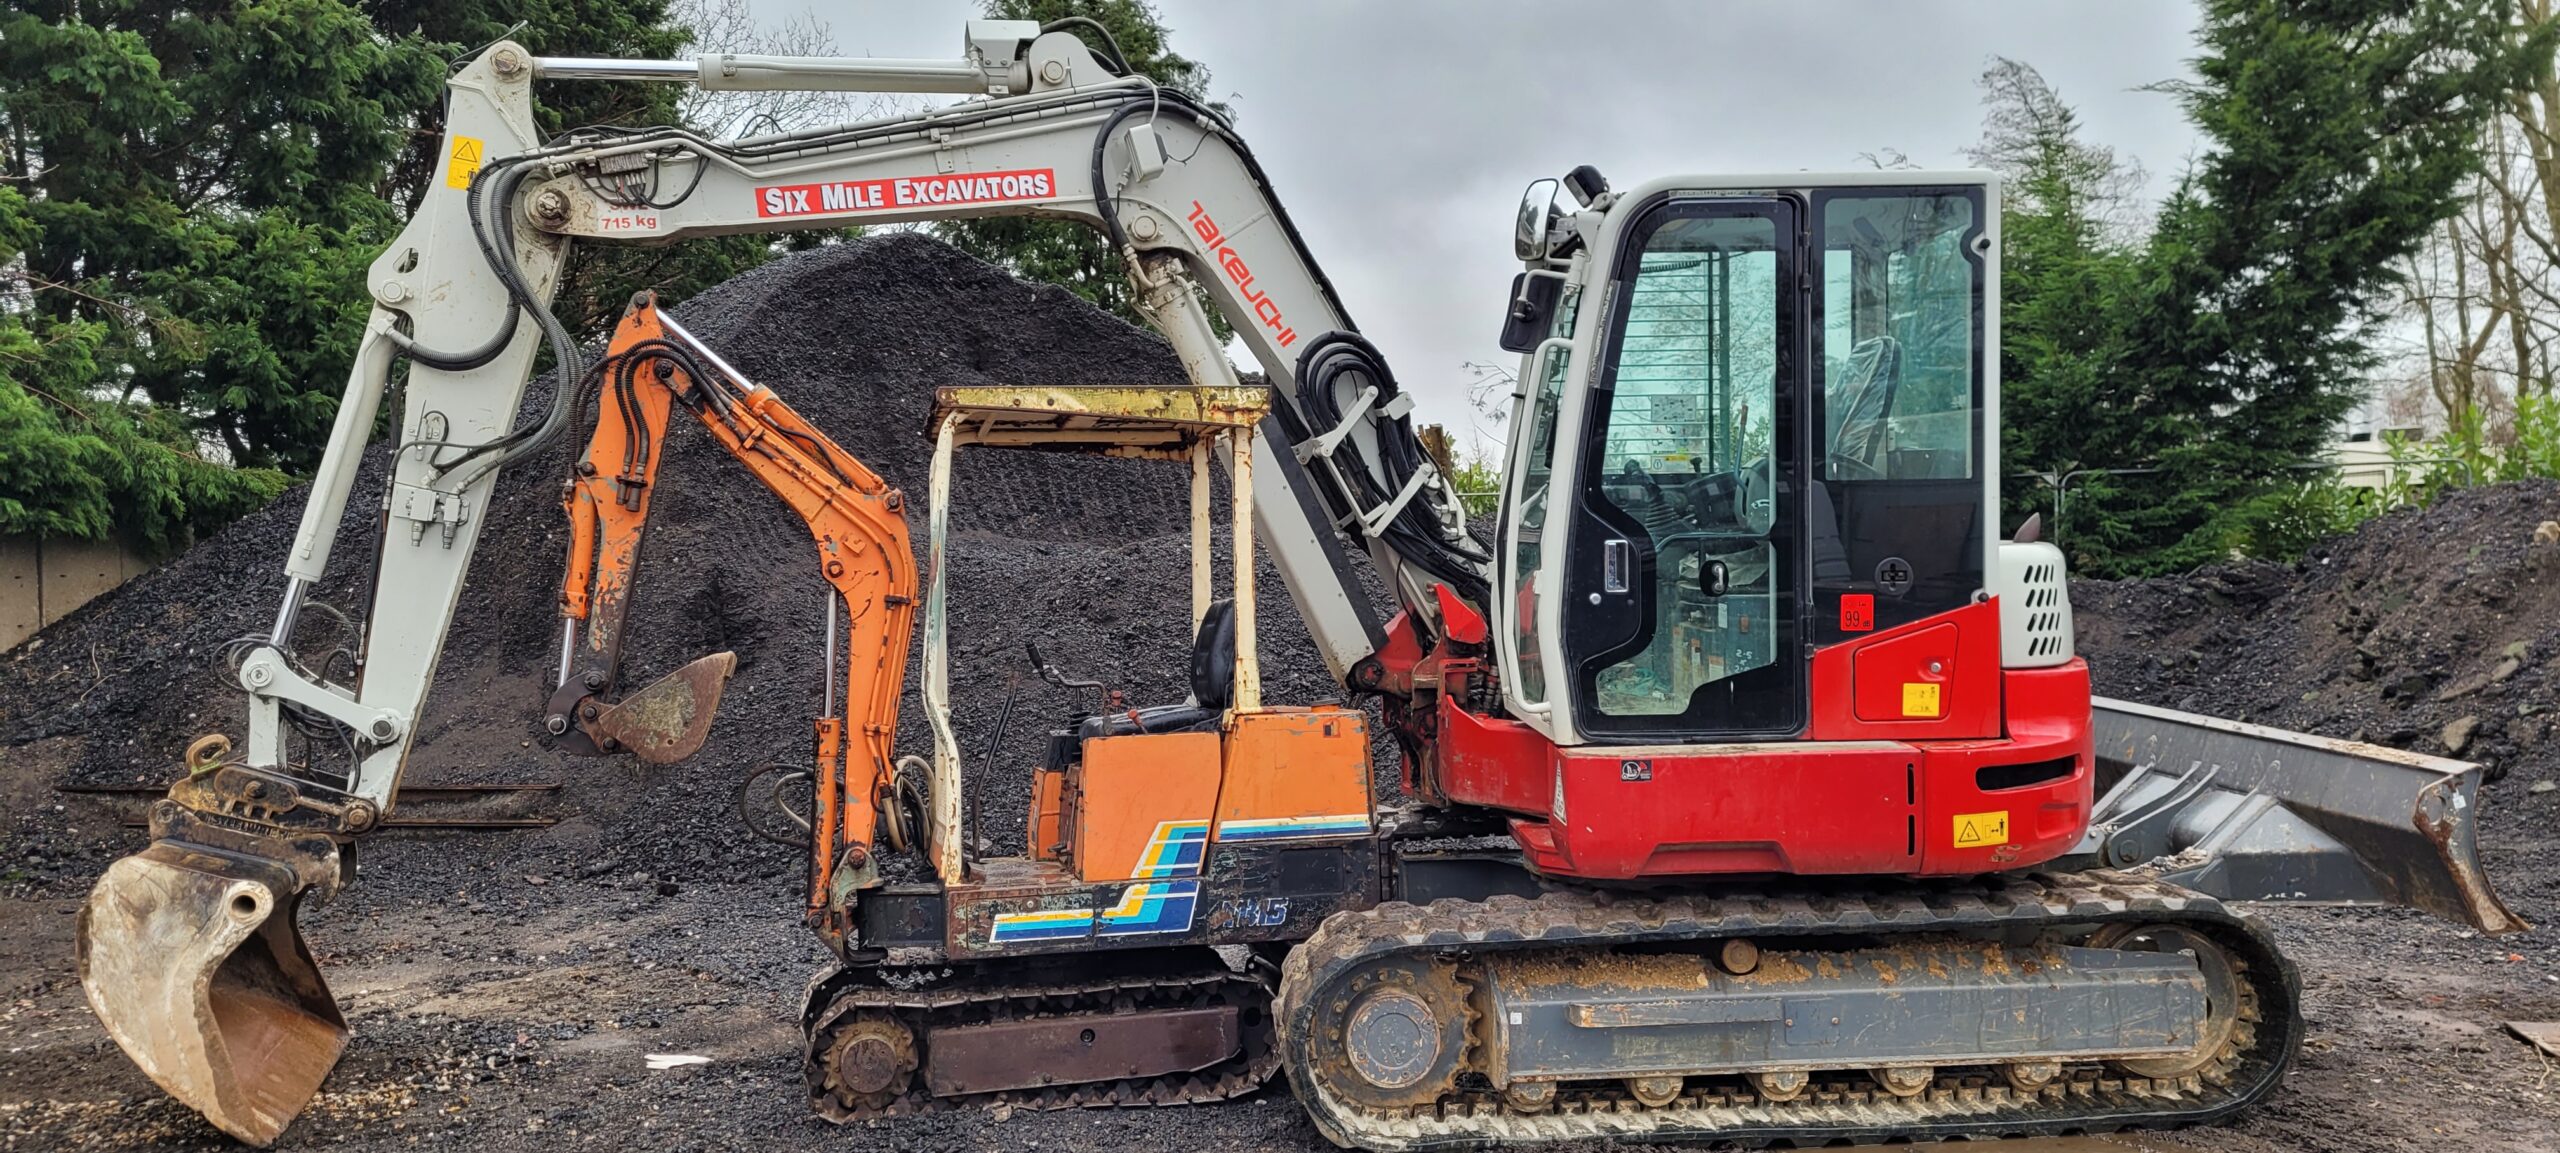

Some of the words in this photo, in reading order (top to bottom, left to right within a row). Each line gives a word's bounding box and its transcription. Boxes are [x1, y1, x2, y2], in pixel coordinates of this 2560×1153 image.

[601, 217, 631, 230] 715
[635, 214, 657, 230] kg
[1845, 610, 1860, 627] 99
